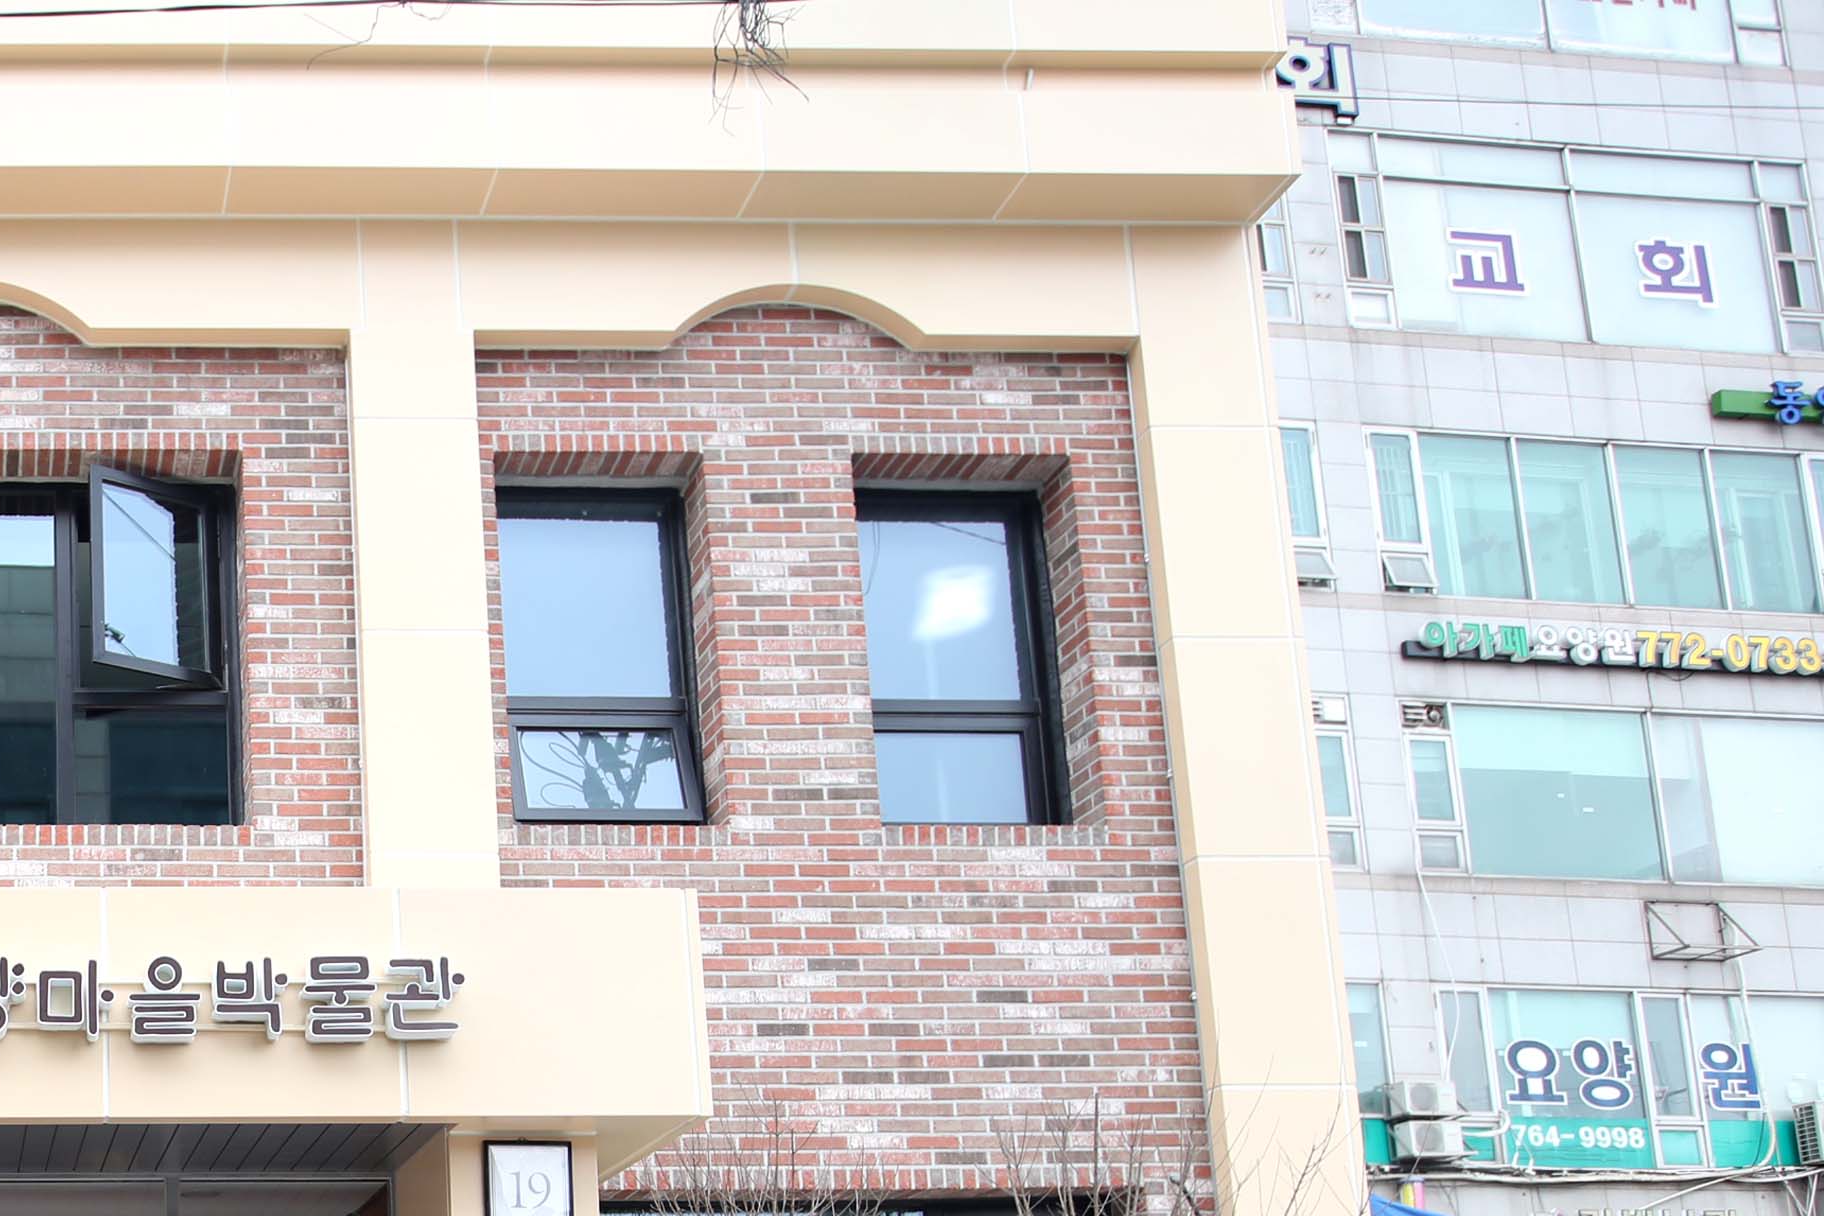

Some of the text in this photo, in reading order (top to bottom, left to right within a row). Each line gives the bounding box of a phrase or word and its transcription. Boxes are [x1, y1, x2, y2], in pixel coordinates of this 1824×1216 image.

[1637, 630, 1823, 674] 772-0733
[1511, 1123, 1646, 1150] 764-9998
[509, 1171, 552, 1209] 19
